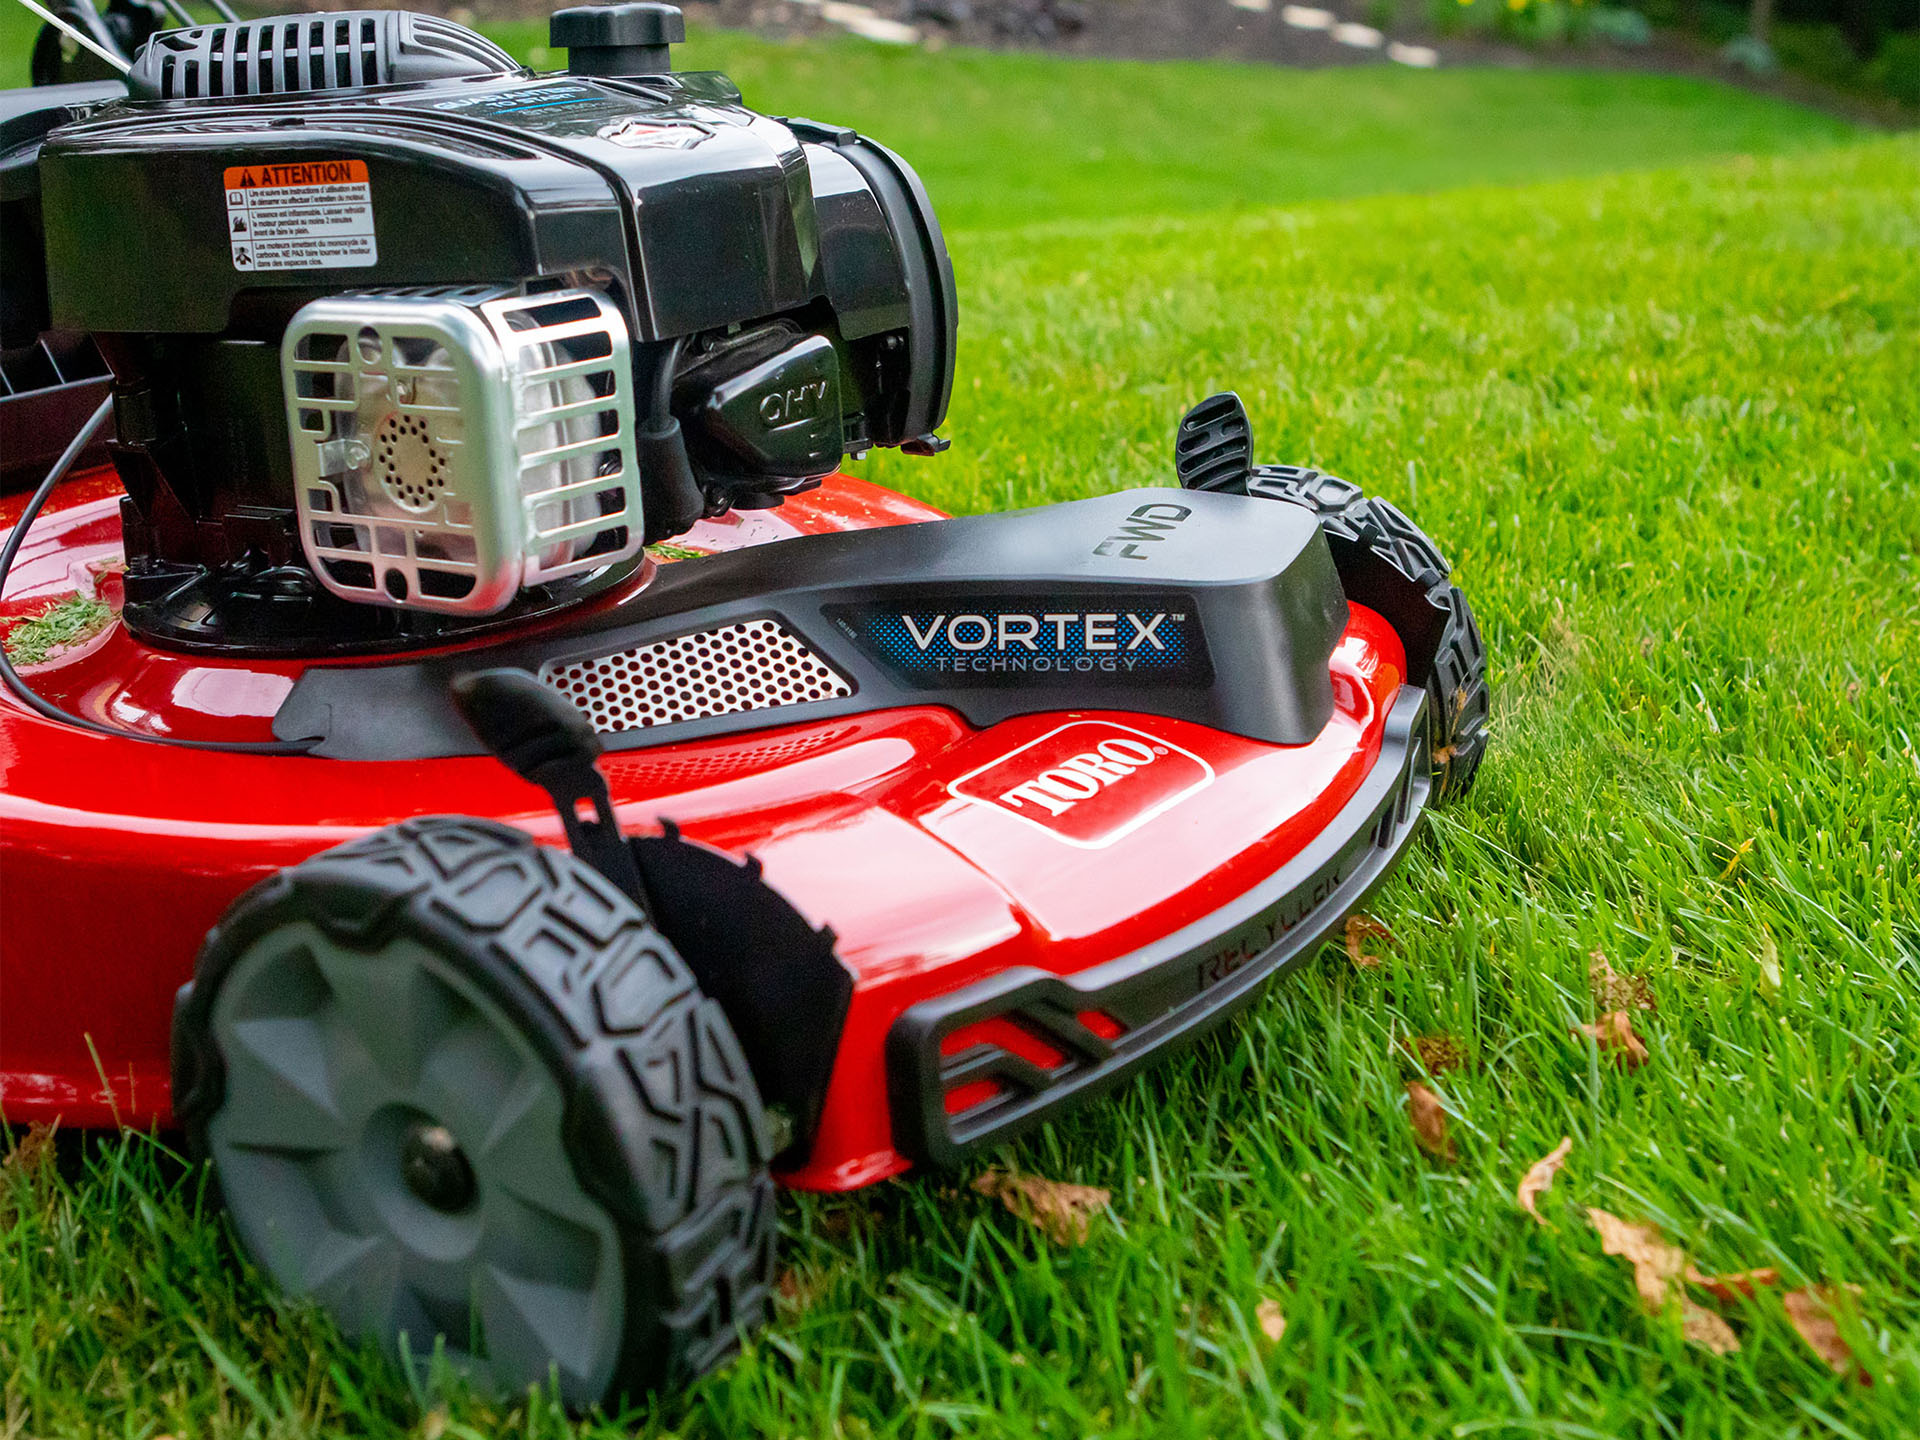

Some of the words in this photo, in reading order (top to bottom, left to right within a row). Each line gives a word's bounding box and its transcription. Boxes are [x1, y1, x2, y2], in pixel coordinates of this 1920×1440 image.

[262, 162, 352, 185] ATTENTION
[289, 186, 320, 195] instructions
[278, 219, 299, 228] pendant
[326, 216, 330, 224] 2
[255, 242, 265, 250] Les
[327, 238, 359, 247] monoxyde
[291, 249, 304, 257] PAS
[1092, 503, 1193, 560] FWD
[935, 656, 1139, 672] TECHNOLOGY
